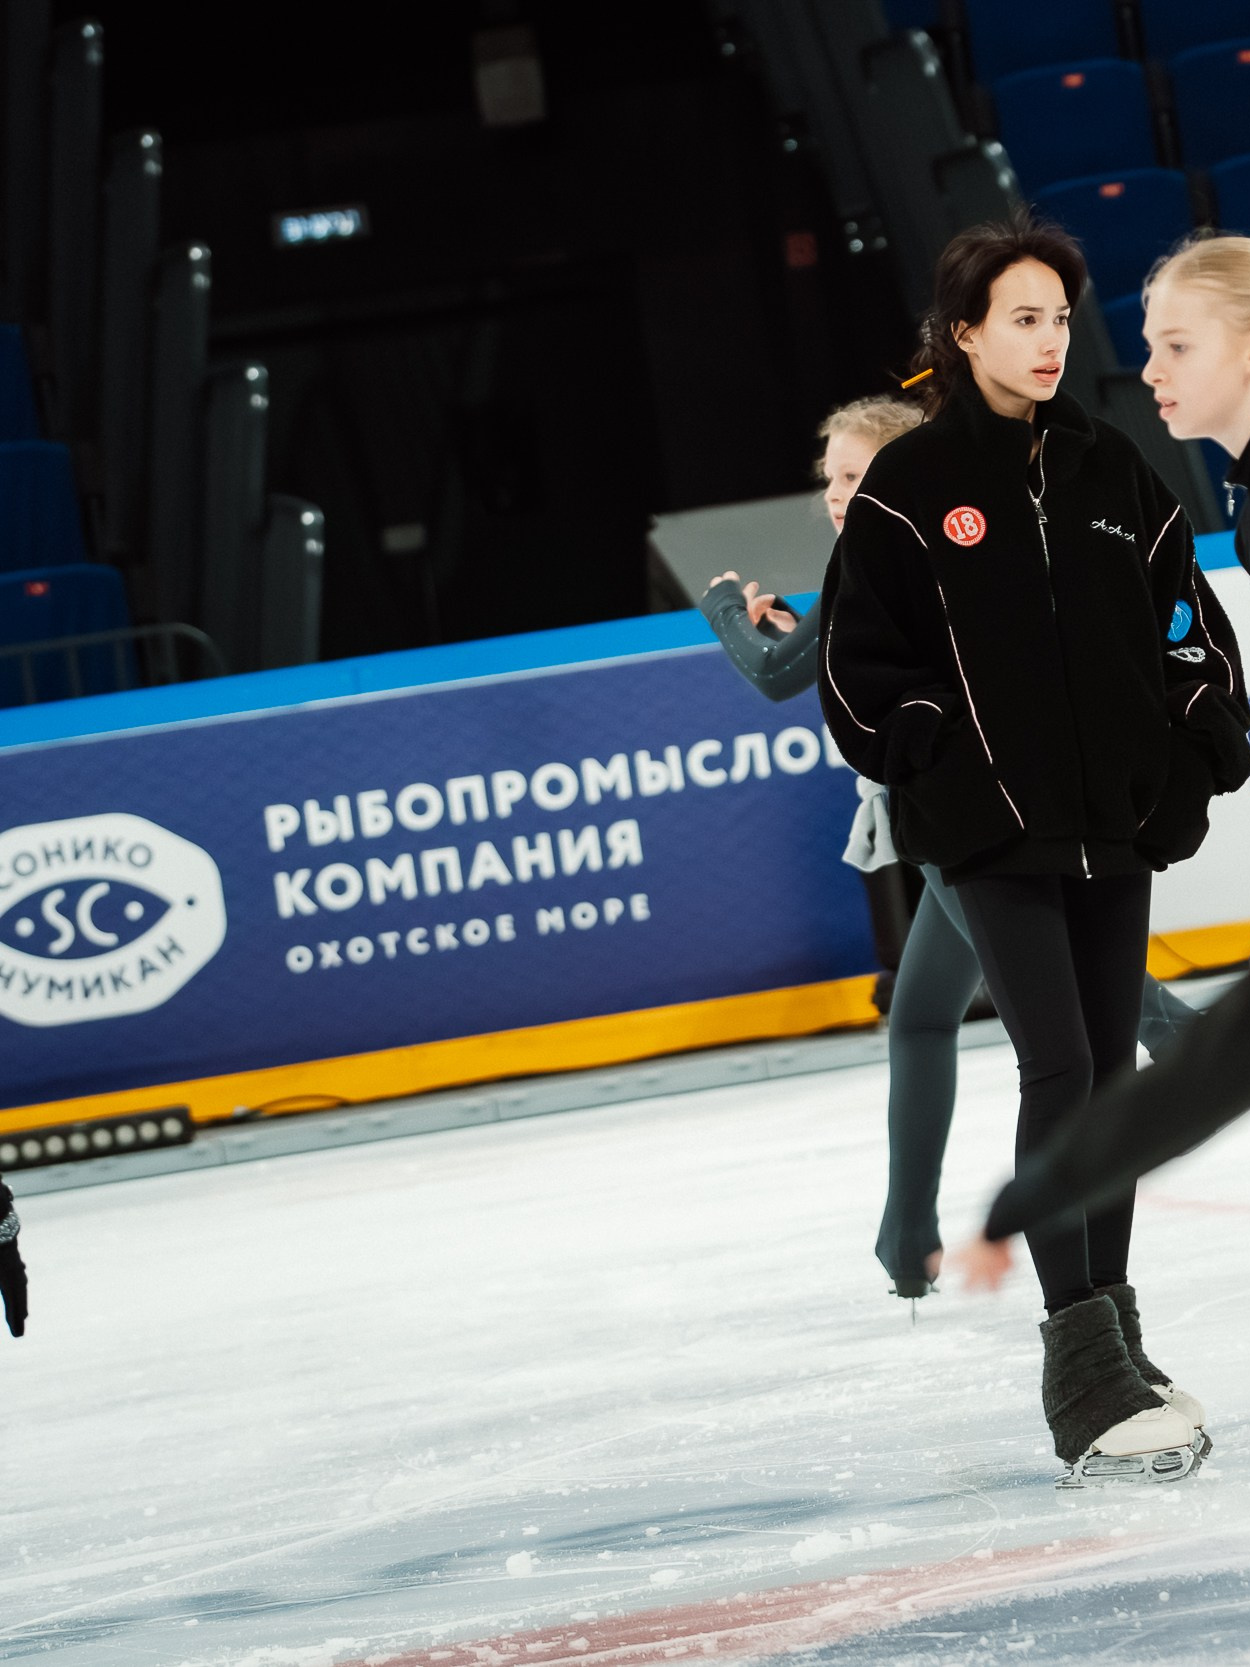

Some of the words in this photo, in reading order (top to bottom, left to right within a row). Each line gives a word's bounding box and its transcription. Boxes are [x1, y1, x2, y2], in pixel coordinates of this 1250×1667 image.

[950, 512, 979, 539] 18
[274, 818, 643, 919] КОМПАНИЯ
[285, 913, 517, 974] ОХОТСКОЕ
[536, 893, 651, 936] МОРЕ
